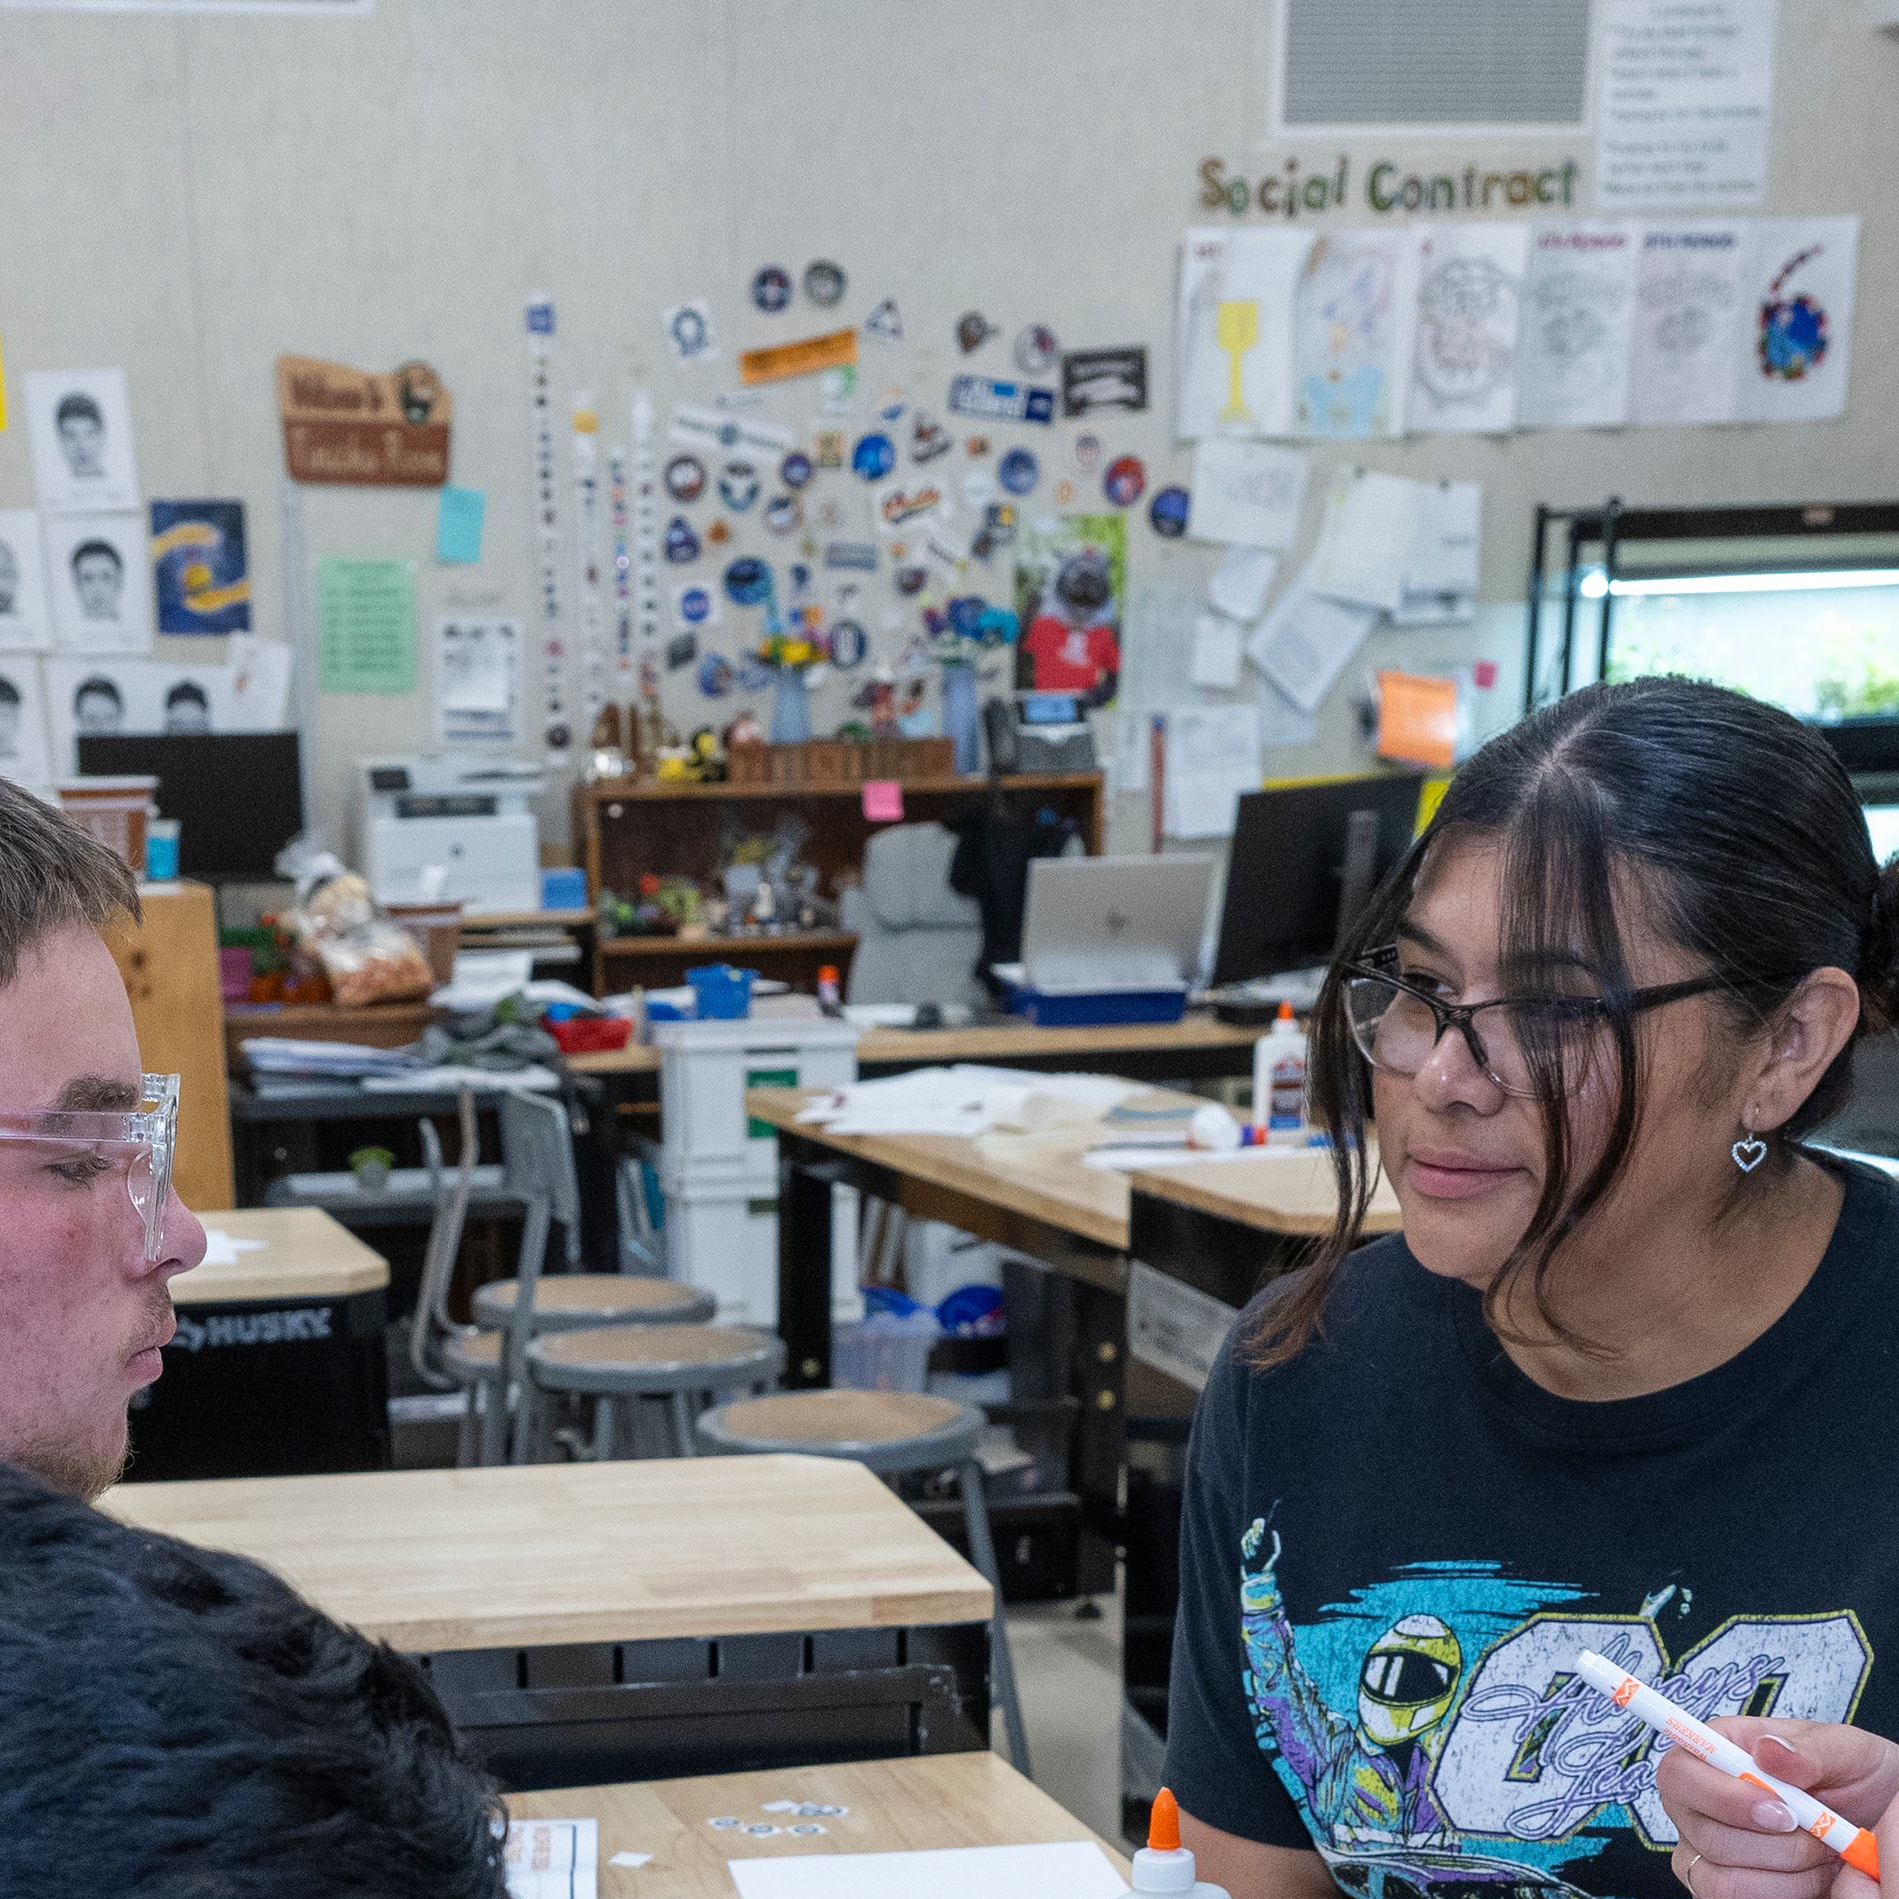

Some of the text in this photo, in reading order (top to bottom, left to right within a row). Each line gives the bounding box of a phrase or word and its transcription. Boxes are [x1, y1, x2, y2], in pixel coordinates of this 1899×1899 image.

[1199, 155, 1581, 218] Social Contract
[207, 1308, 333, 1348] HUSKY
[1666, 1717, 1717, 1754] MARKERS
